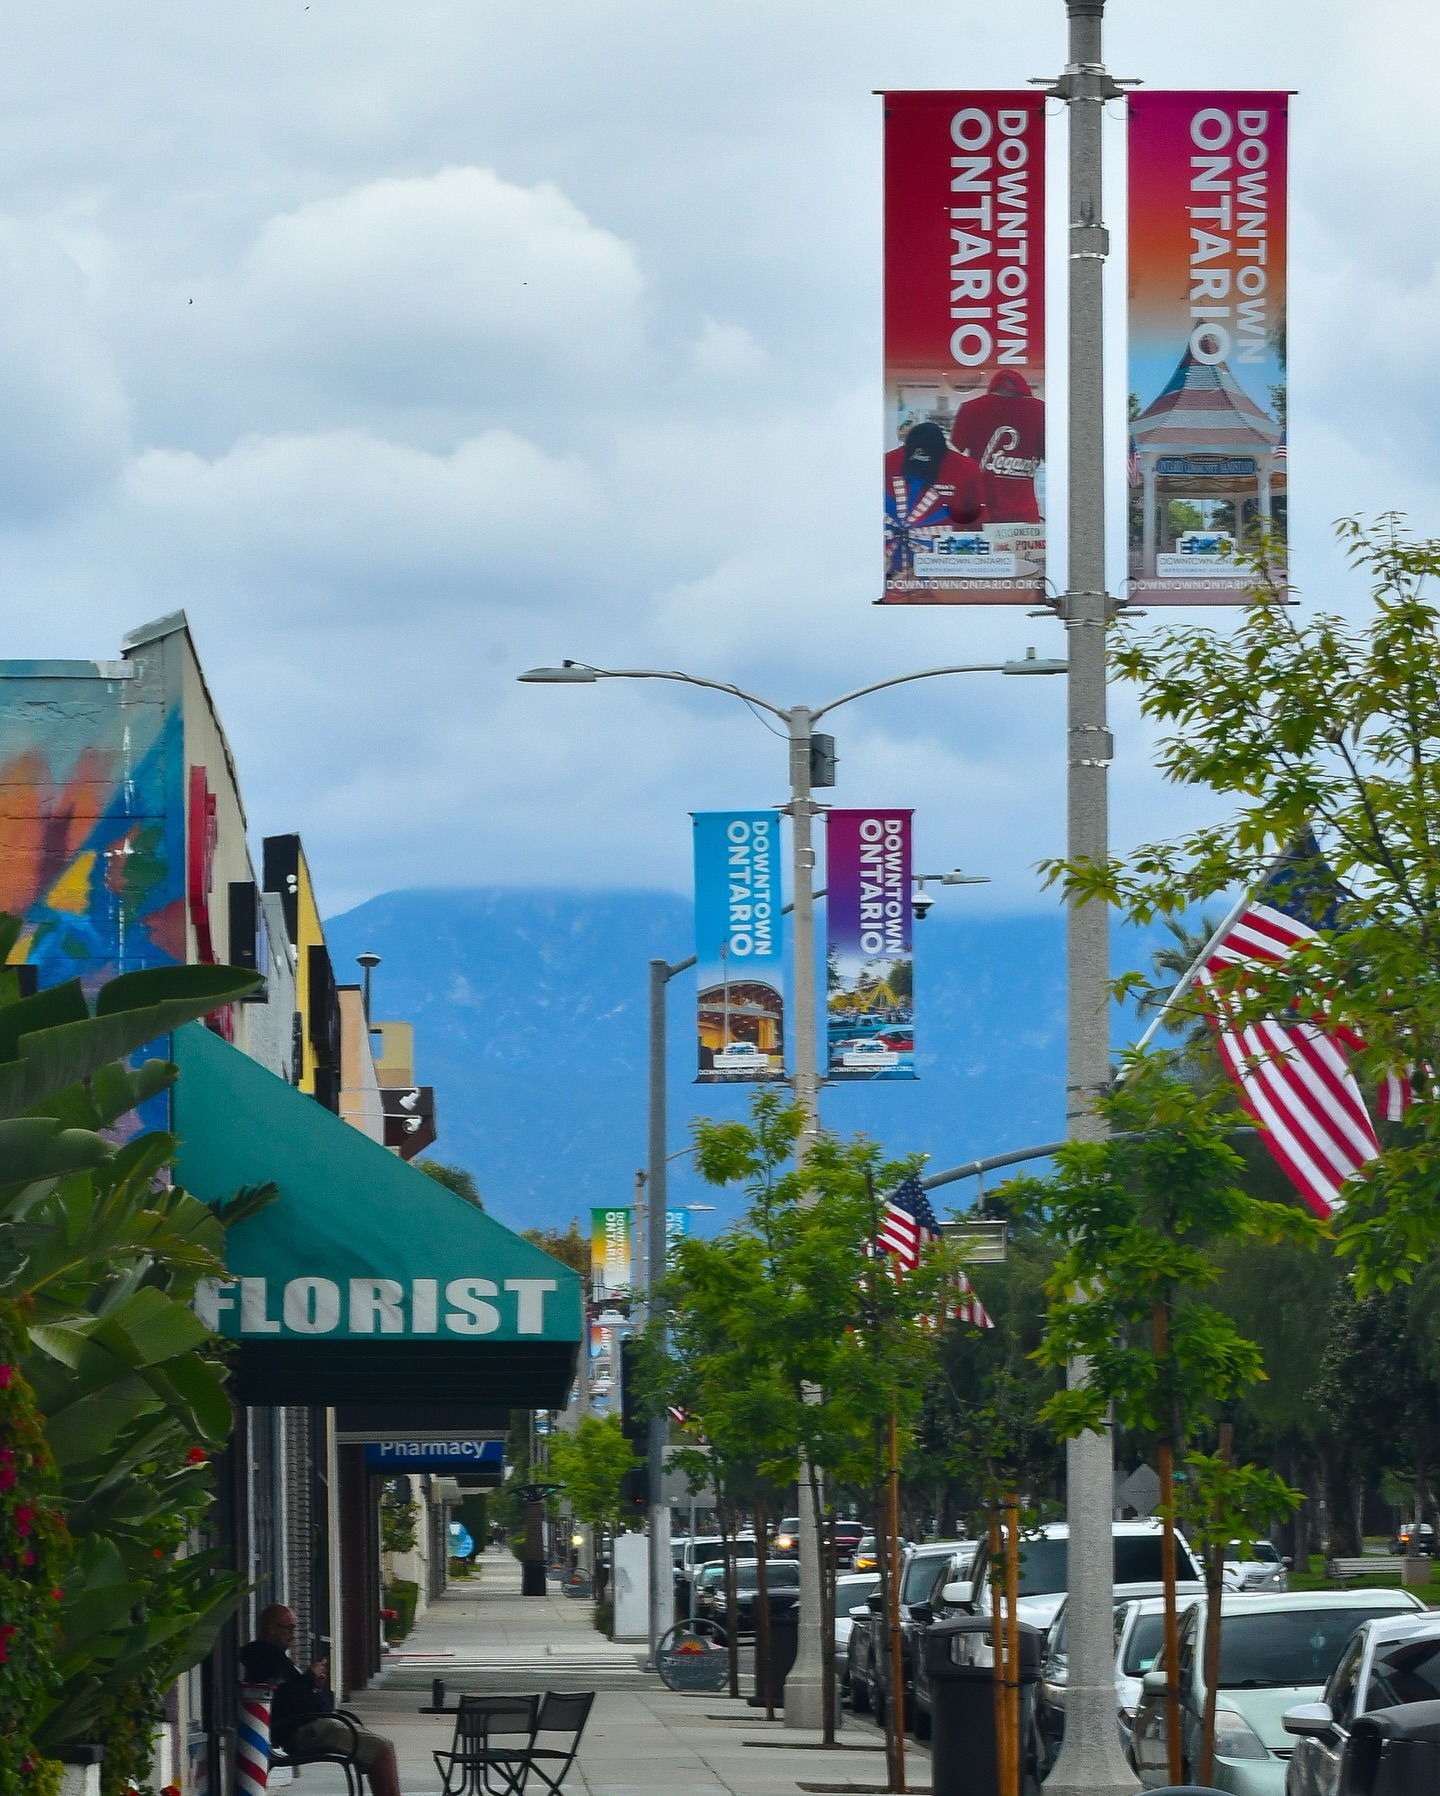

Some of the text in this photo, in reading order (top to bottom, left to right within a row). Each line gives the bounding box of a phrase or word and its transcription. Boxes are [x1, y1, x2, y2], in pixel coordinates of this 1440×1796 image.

[950, 108, 992, 367] ONTARIO
[997, 109, 1028, 365] DOWNTOWN
[1190, 108, 1232, 366] ONTARIO
[1236, 109, 1268, 364] DOWNTOWN
[886, 579, 1044, 590] DOWNTOWNONTARIO.ORG
[917, 557, 1010, 565] DOWNTOWN ONTARIO
[1160, 557, 1213, 565] DOWNTOWN
[728, 820, 752, 956] ONTARIO
[752, 821, 771, 955] DOWNTOWN
[860, 819, 883, 954] ONTARIO
[884, 819, 903, 954] DOWNTOWN
[194, 1277, 557, 1335] FLORIST
[380, 1441, 486, 1459] Pharmacy
